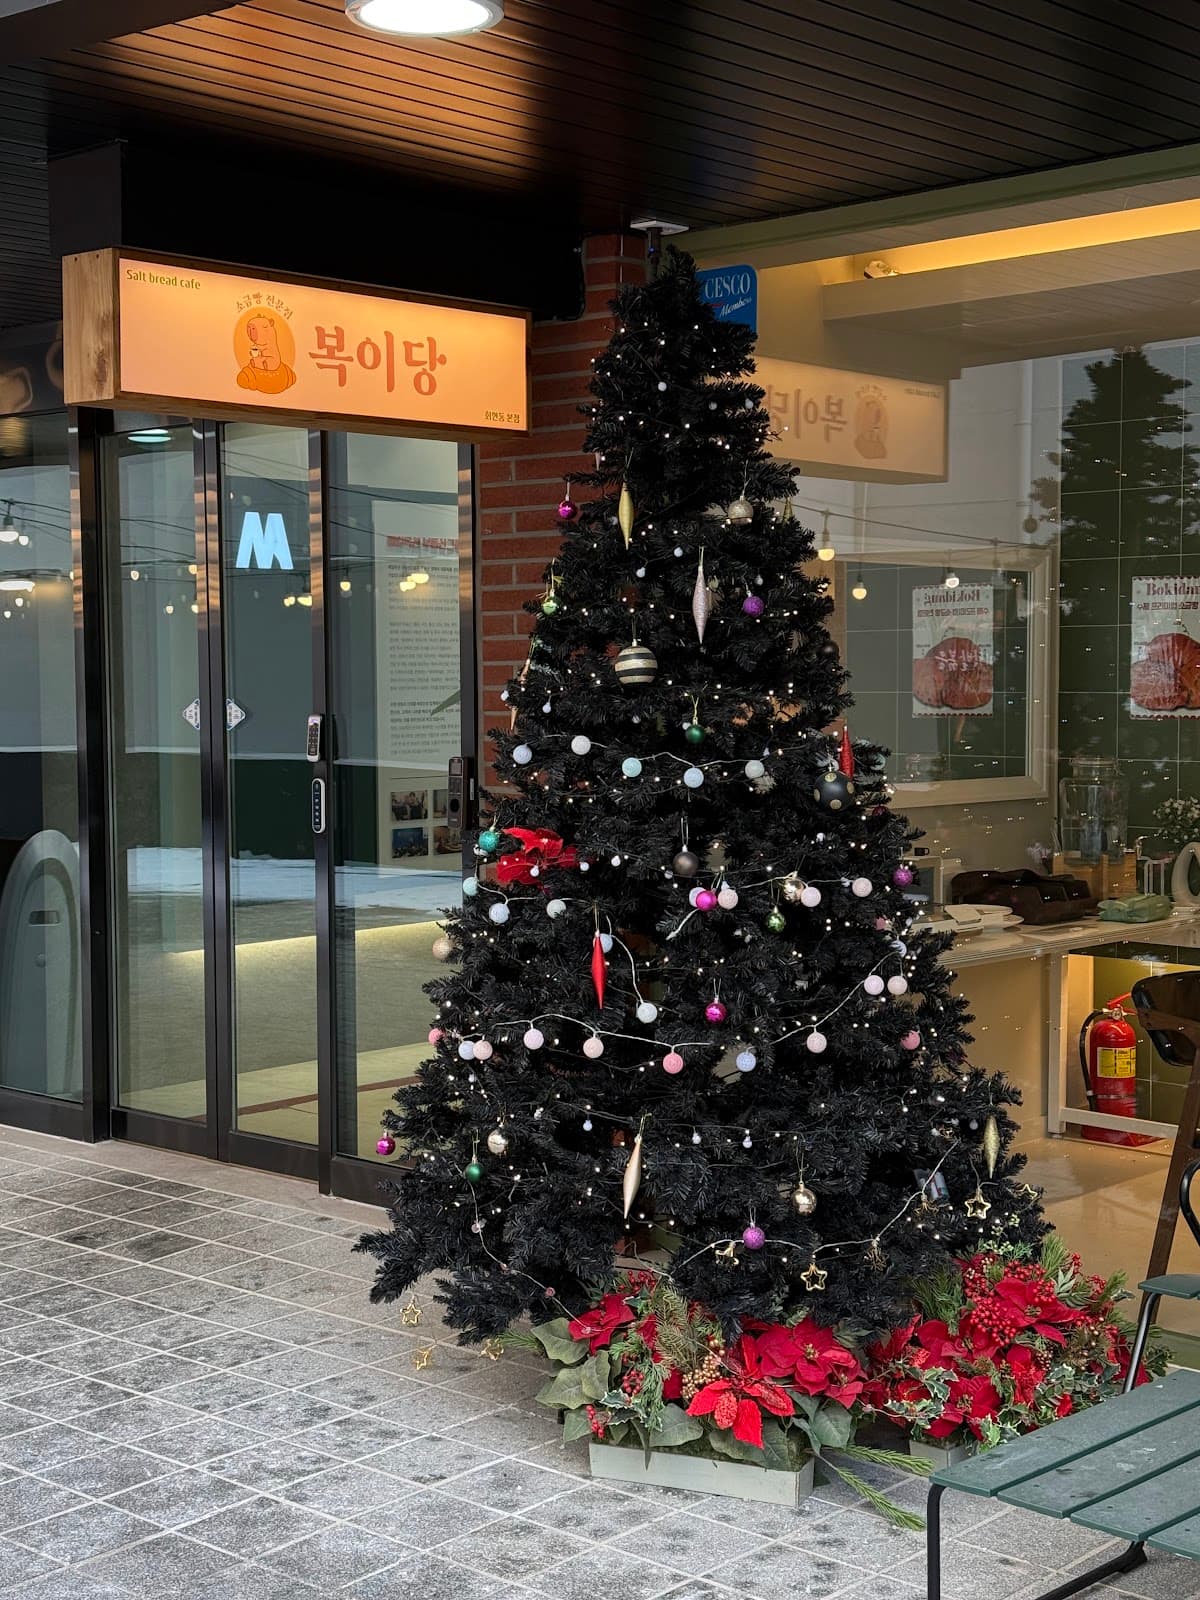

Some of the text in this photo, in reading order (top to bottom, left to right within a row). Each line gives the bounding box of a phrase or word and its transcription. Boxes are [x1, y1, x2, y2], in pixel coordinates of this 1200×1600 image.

[126, 269, 201, 290] Salt bread cafe
[704, 271, 751, 299] CESCO
[236, 291, 263, 313] 소금빵
[308, 325, 447, 396] 복이당
[506, 413, 520, 424] 본점
